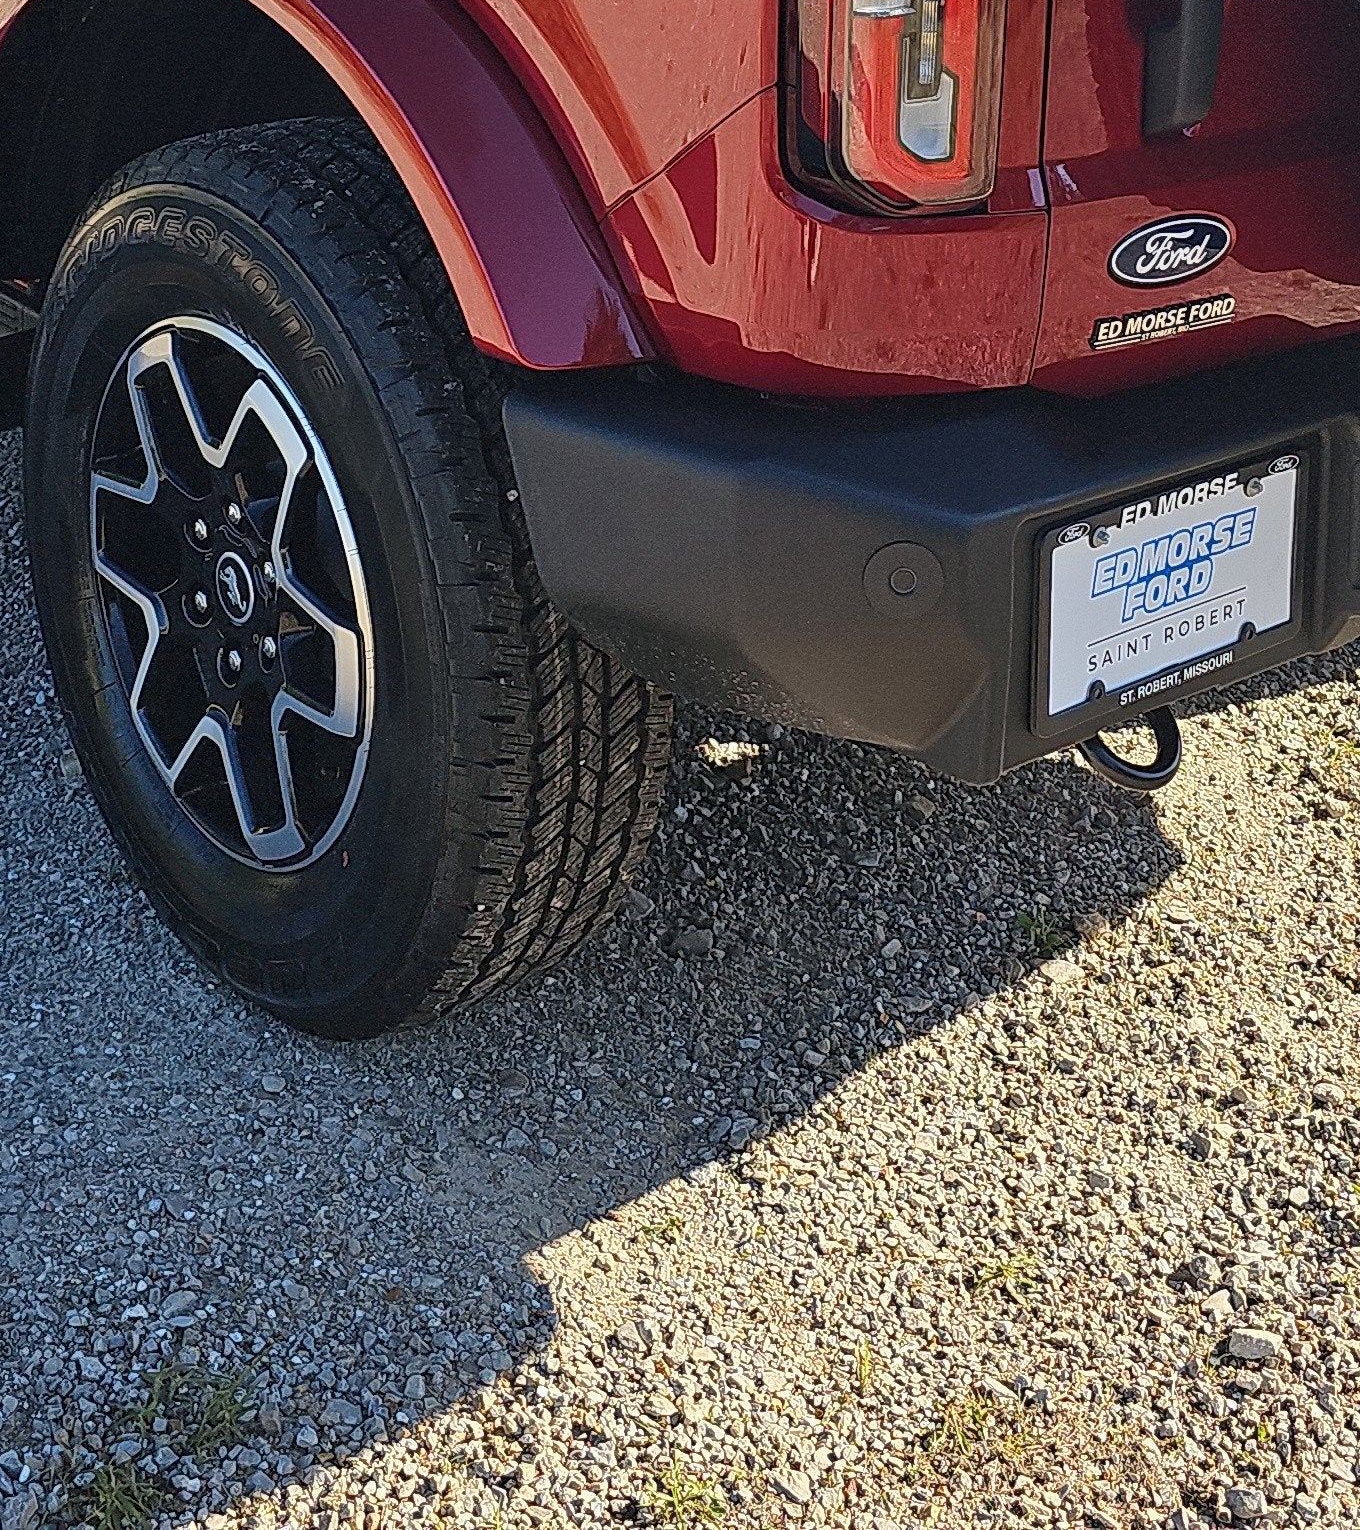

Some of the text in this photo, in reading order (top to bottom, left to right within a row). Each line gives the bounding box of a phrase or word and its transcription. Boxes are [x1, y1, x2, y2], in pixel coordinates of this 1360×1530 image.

[1135, 228, 1211, 274] Ford
[48, 206, 346, 392] RIDGESTONE
[1097, 297, 1236, 341] ED MORSE FORD
[1120, 473, 1240, 529] ED MORSE
[1091, 507, 1257, 598] ED MORSE
[1122, 556, 1215, 623] FORD
[1087, 599, 1247, 672] SAINT ROBERT
[1119, 650, 1233, 706] ST. ROBERT, MISSOURI
